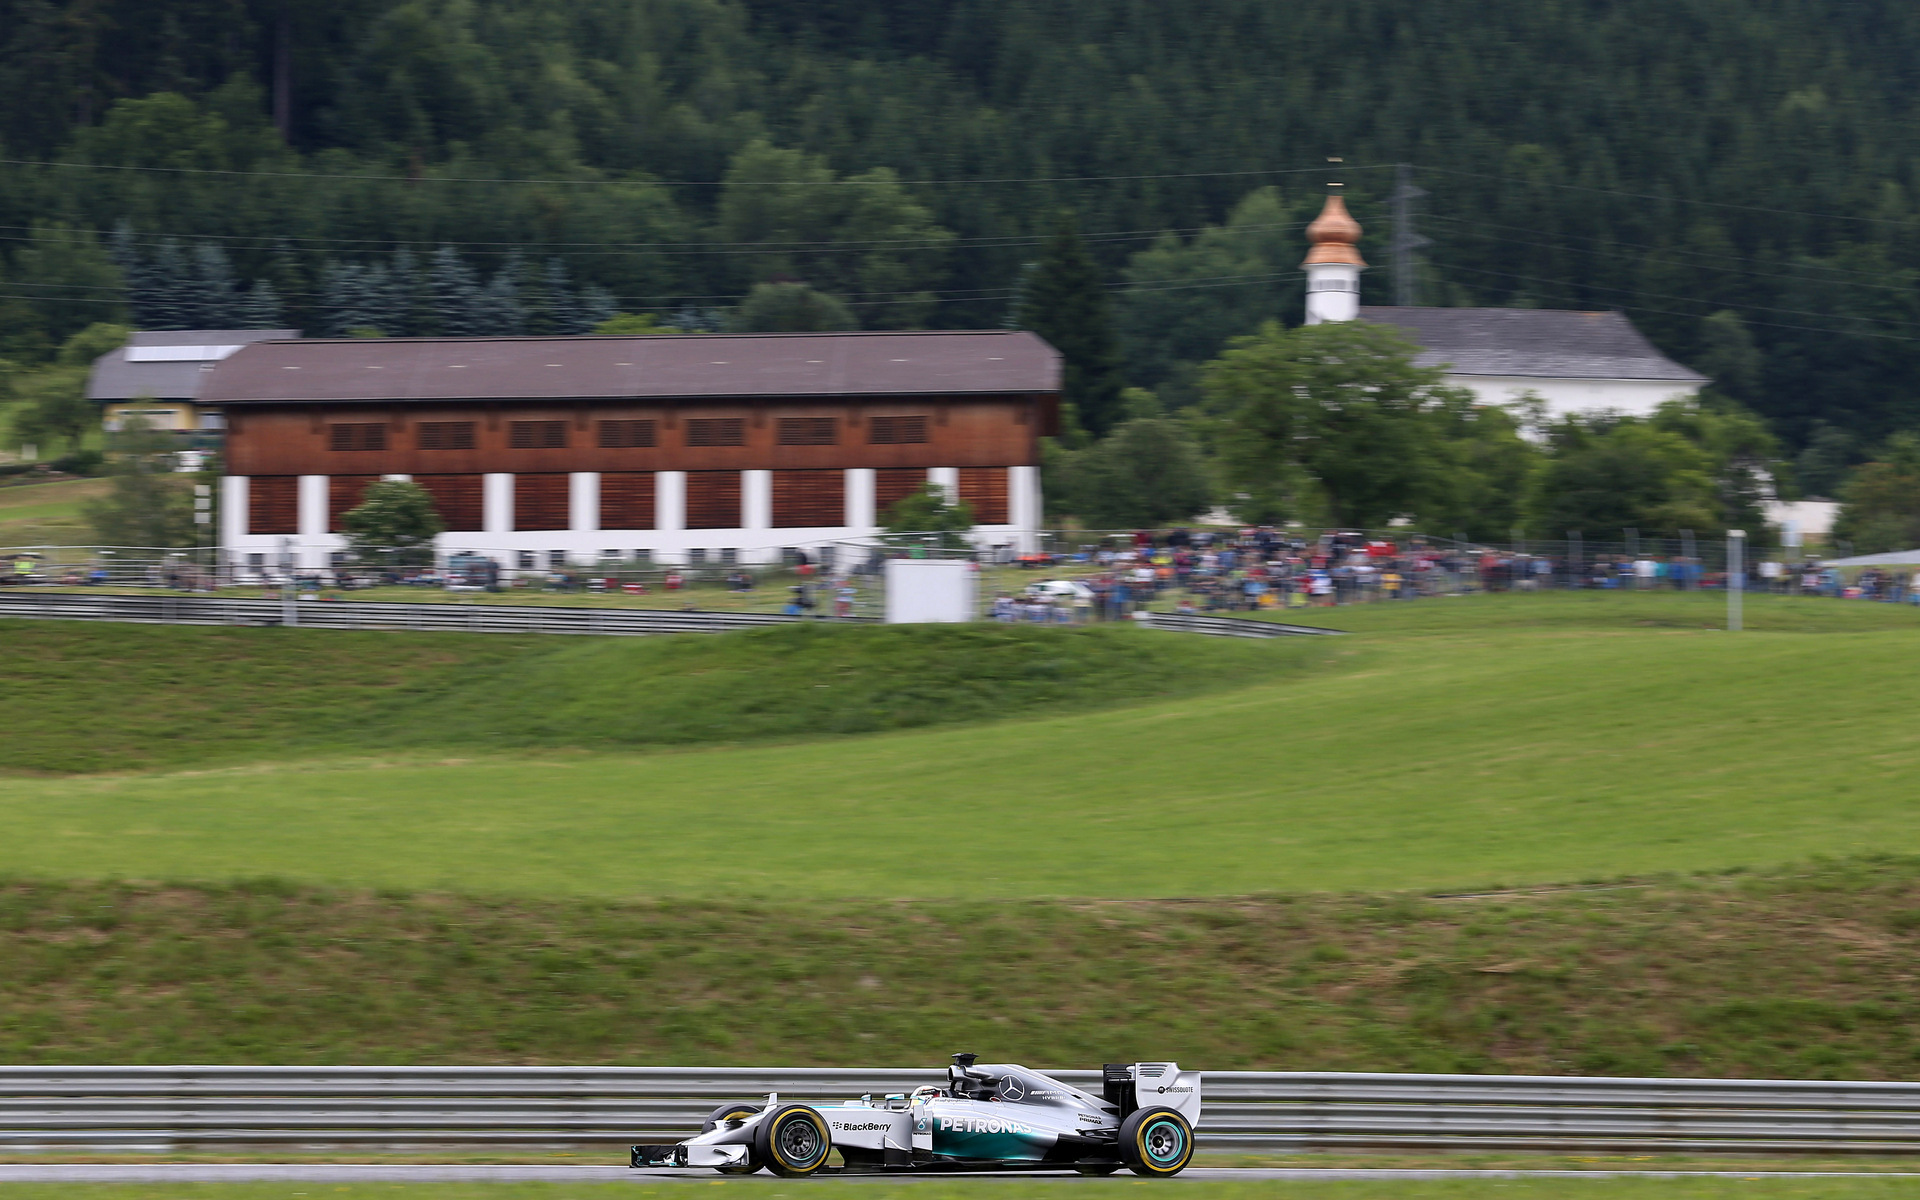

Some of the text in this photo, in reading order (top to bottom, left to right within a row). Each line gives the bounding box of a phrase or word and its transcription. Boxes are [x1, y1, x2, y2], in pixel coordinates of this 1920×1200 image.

[940, 1117, 1032, 1134] PETRONAS
[1079, 1117, 1102, 1125] PRIMAX
[843, 1122, 892, 1133] BlackBerry
